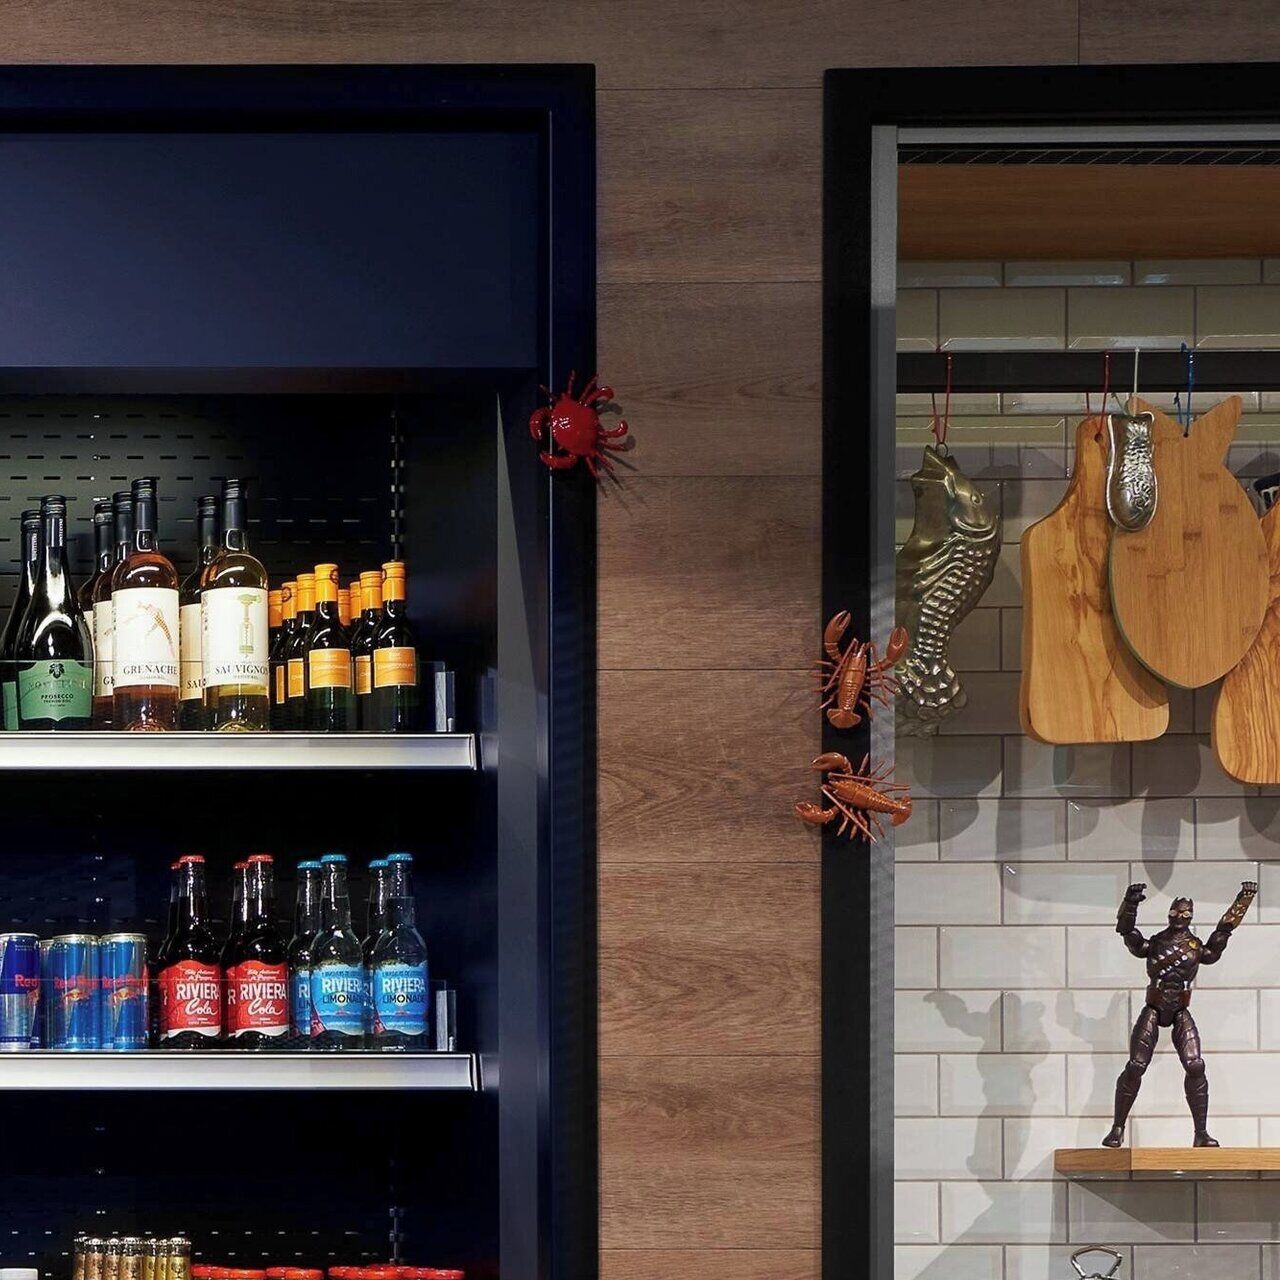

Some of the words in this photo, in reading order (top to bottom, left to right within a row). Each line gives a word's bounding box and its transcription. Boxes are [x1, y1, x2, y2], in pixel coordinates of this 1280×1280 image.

[123, 665, 178, 676] GRENACHE
[240, 983, 287, 1000] RIVIERA
[382, 977, 427, 993] RIVIERA
[186, 998, 218, 1016] Cola
[248, 998, 283, 1016] Cola
